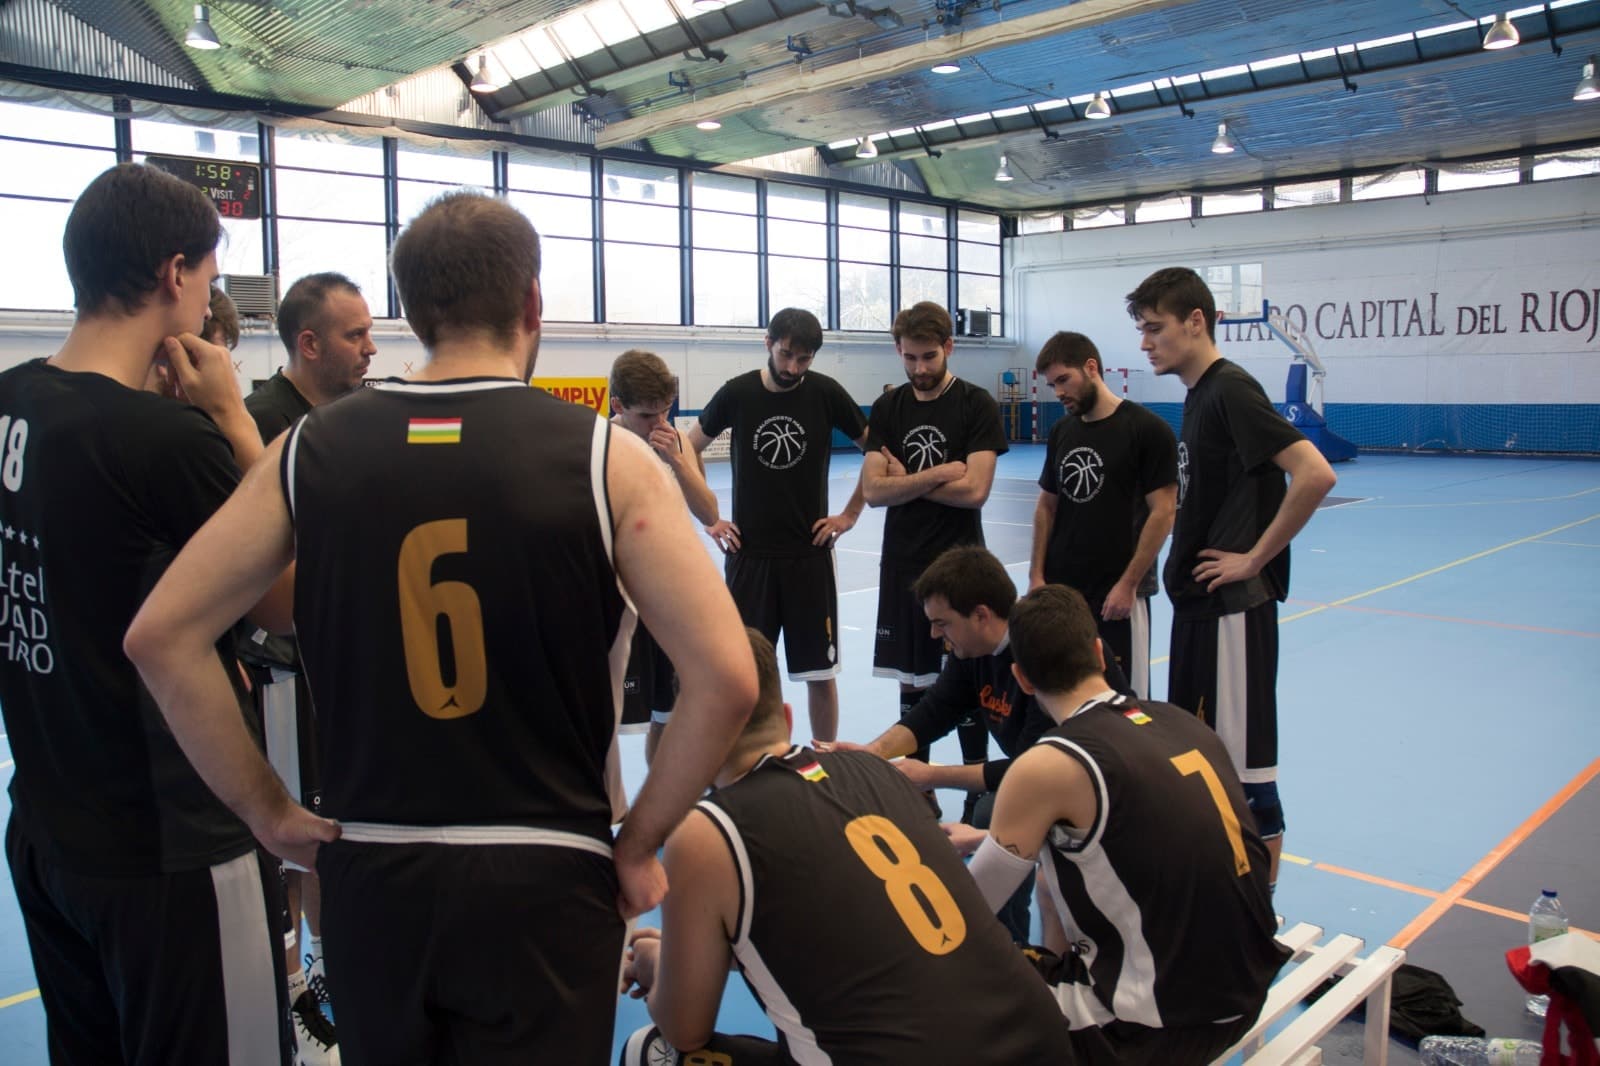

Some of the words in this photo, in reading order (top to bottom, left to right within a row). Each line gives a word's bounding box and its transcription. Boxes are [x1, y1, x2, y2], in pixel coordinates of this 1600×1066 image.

[196, 164, 231, 180] 1:58
[1315, 292, 1446, 340] CAPITAL
[1456, 304, 1507, 336] DEL
[542, 386, 606, 413] MPLY
[398, 518, 488, 720] 6
[1169, 749, 1251, 877] 7
[844, 814, 967, 956] 8
